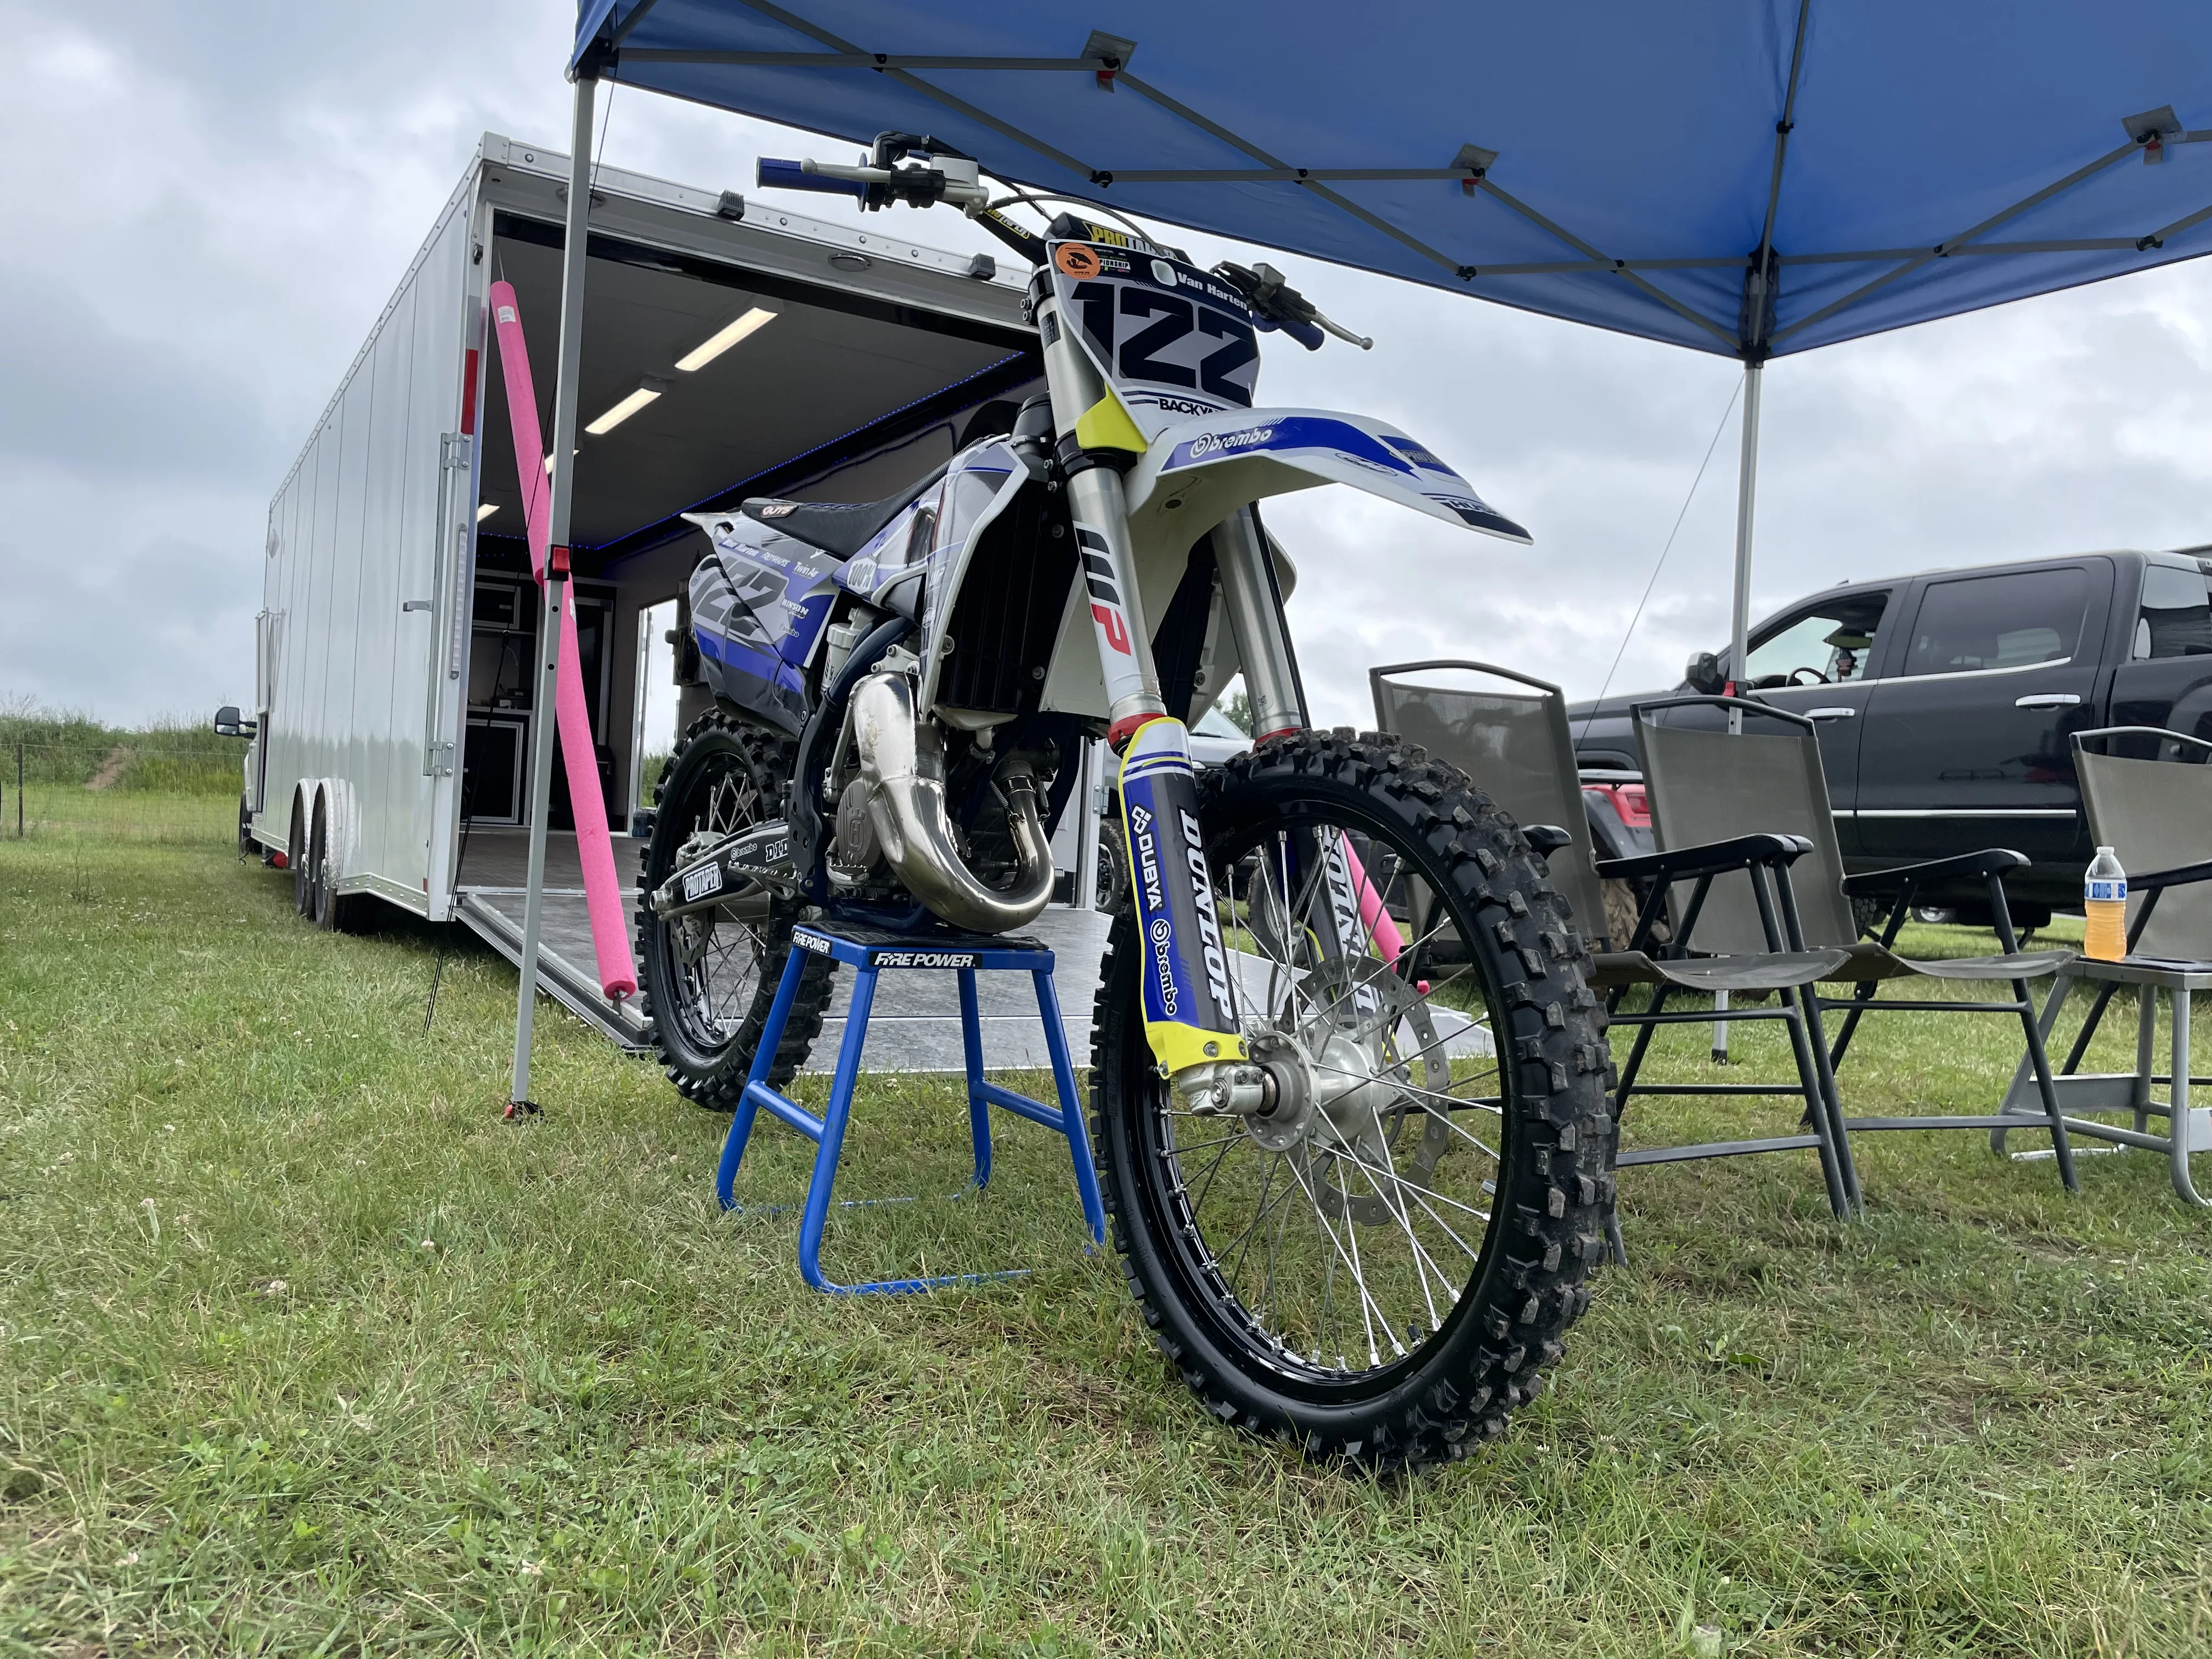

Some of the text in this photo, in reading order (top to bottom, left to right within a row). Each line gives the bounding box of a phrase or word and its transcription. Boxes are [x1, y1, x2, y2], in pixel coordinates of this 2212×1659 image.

[1177, 272, 1248, 311] Van Harten
[1071, 281, 1259, 408] 122
[1208, 427, 1273, 452] brembo
[763, 506, 791, 515] GUTS
[794, 561, 810, 574] Twin
[809, 568, 820, 578] Air
[848, 563, 876, 588] 100%
[781, 599, 810, 616] HINSON
[685, 865, 720, 898] PROTAPER
[1138, 832, 1163, 911] DUBYA
[1179, 808, 1233, 1020] DUNLOP
[806, 936, 830, 953] POWER
[874, 952, 974, 967] FIRE POWER
[1155, 941, 1178, 1016] brembo
